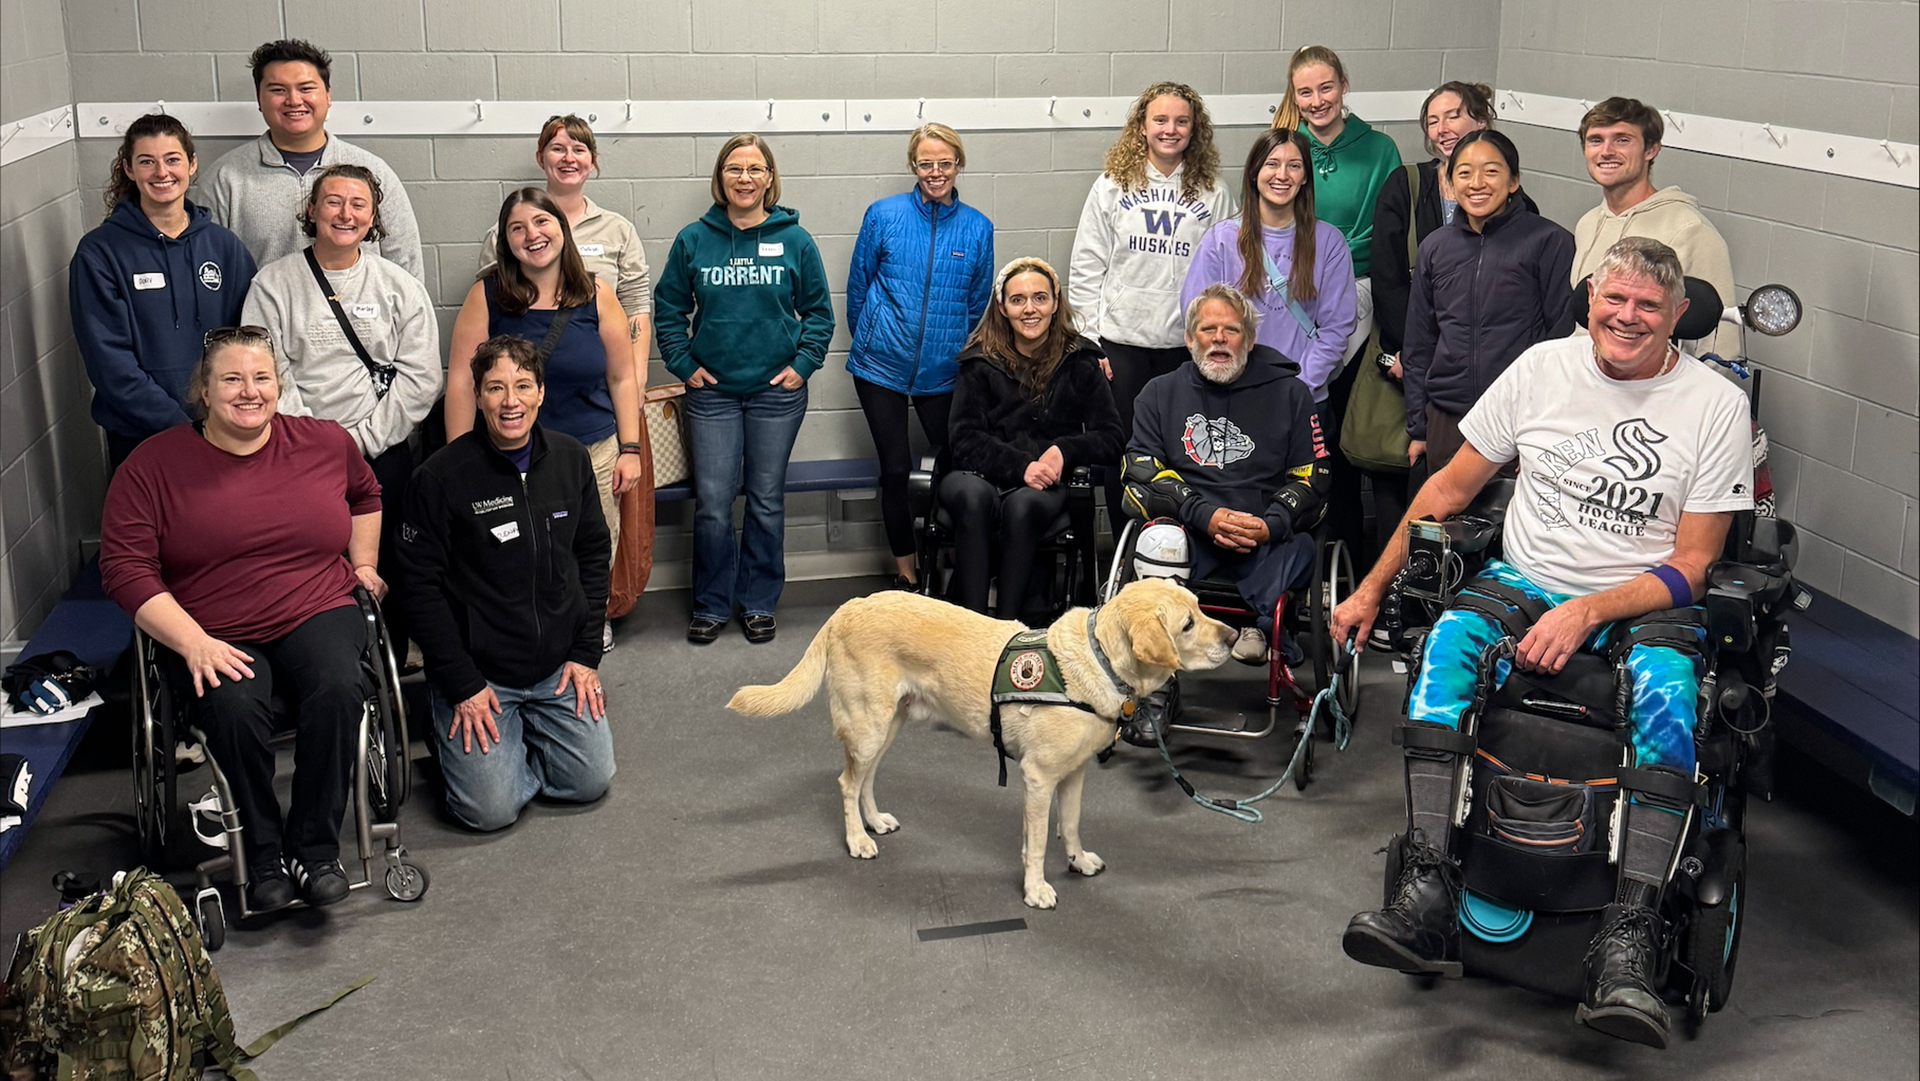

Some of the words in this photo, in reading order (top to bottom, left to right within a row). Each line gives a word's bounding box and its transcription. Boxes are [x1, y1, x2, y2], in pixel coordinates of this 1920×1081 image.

[1119, 188, 1211, 221] WASHINGTON
[1141, 207, 1186, 236] W
[1129, 235, 1190, 257] HUSKIES
[700, 265, 785, 286] TORRENT
[1562, 478, 1592, 493] SINCE
[1586, 475, 1664, 519] 2021
[1577, 503, 1648, 526] HOCKEY
[1578, 515, 1645, 537] LEAGUE
